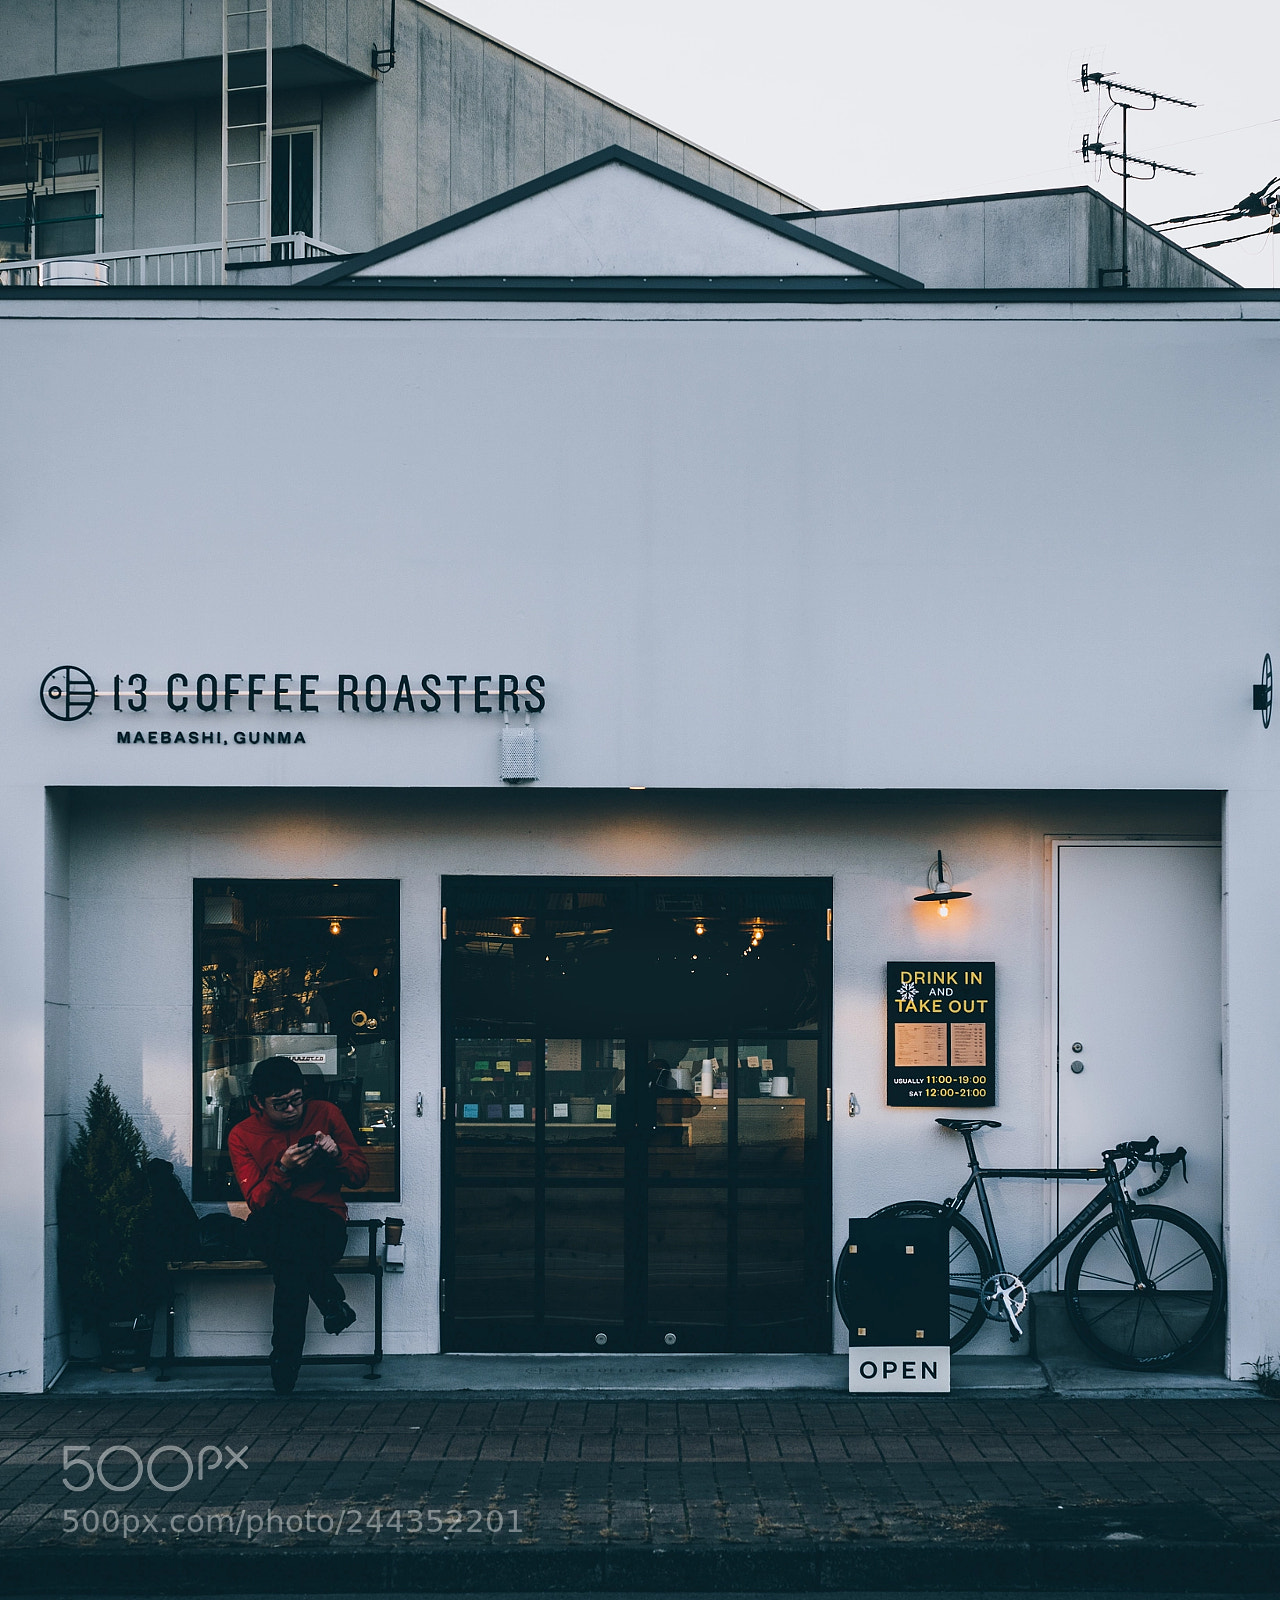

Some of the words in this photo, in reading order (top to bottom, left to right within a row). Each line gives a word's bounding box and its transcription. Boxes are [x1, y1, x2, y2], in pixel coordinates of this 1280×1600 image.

[114, 673, 147, 712] 13
[167, 673, 320, 712] COFFEE
[338, 674, 546, 713] ROASTERS
[117, 731, 228, 745] MAEBASHI,
[233, 731, 306, 744] GUNMA
[900, 971, 958, 985] DRINK
[964, 971, 982, 985] IN
[928, 987, 954, 997] AND
[894, 999, 943, 1013] TAKE
[948, 999, 988, 1013] OUT
[926, 1075, 987, 1084] 11:00-19:00
[925, 1088, 987, 1097] 12:00-21:00
[859, 1361, 937, 1380] OPEN
